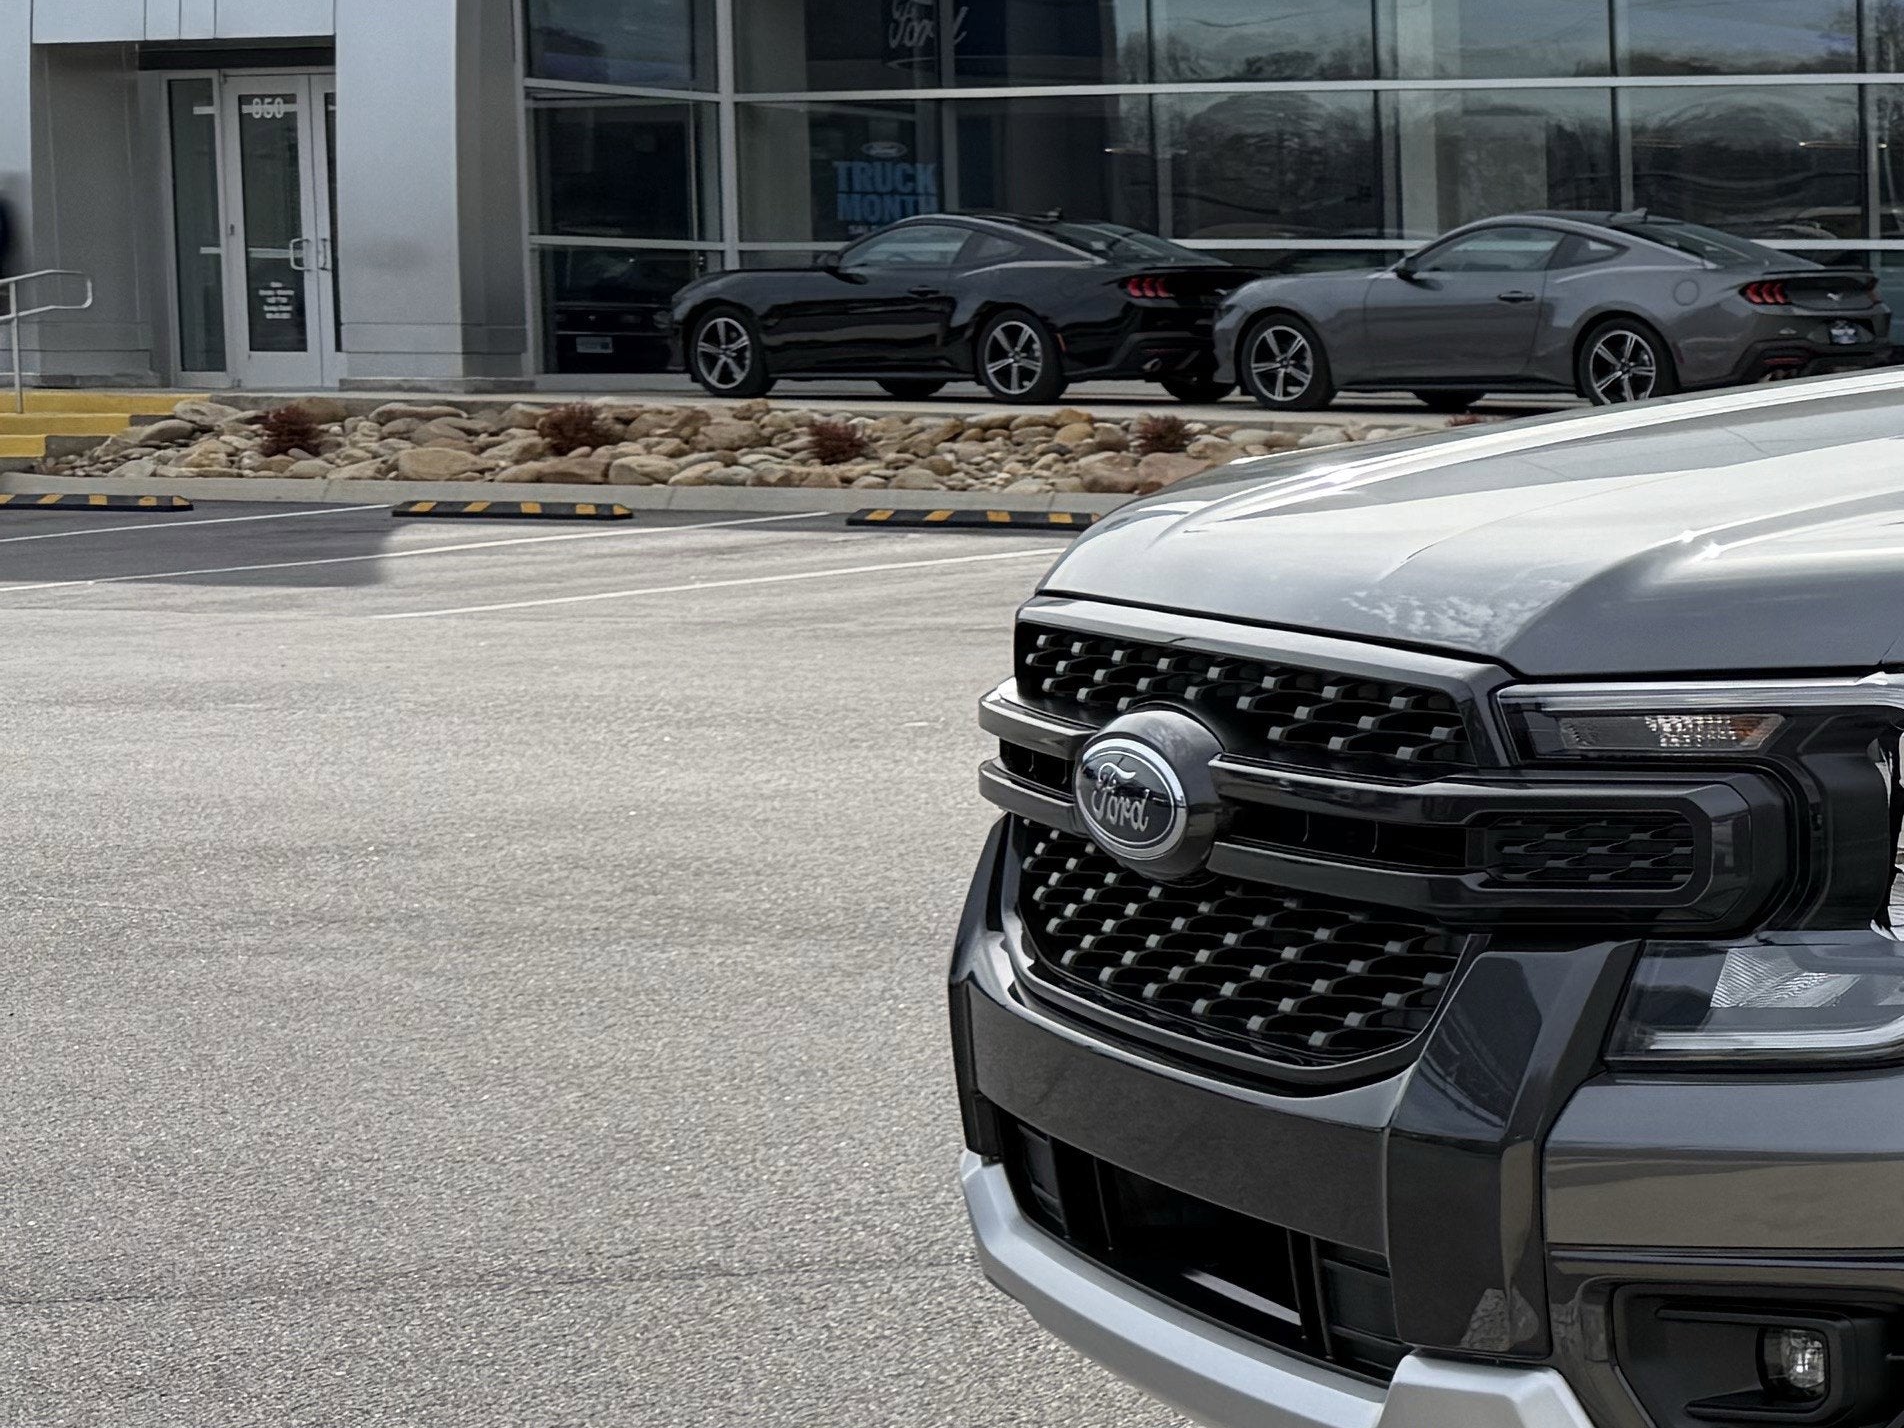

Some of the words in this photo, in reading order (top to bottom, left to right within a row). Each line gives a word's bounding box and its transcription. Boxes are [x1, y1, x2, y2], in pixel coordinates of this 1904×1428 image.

[833, 160, 938, 193] TRUCK
[836, 193, 939, 223] MONTH
[1091, 761, 1151, 833] Ford
